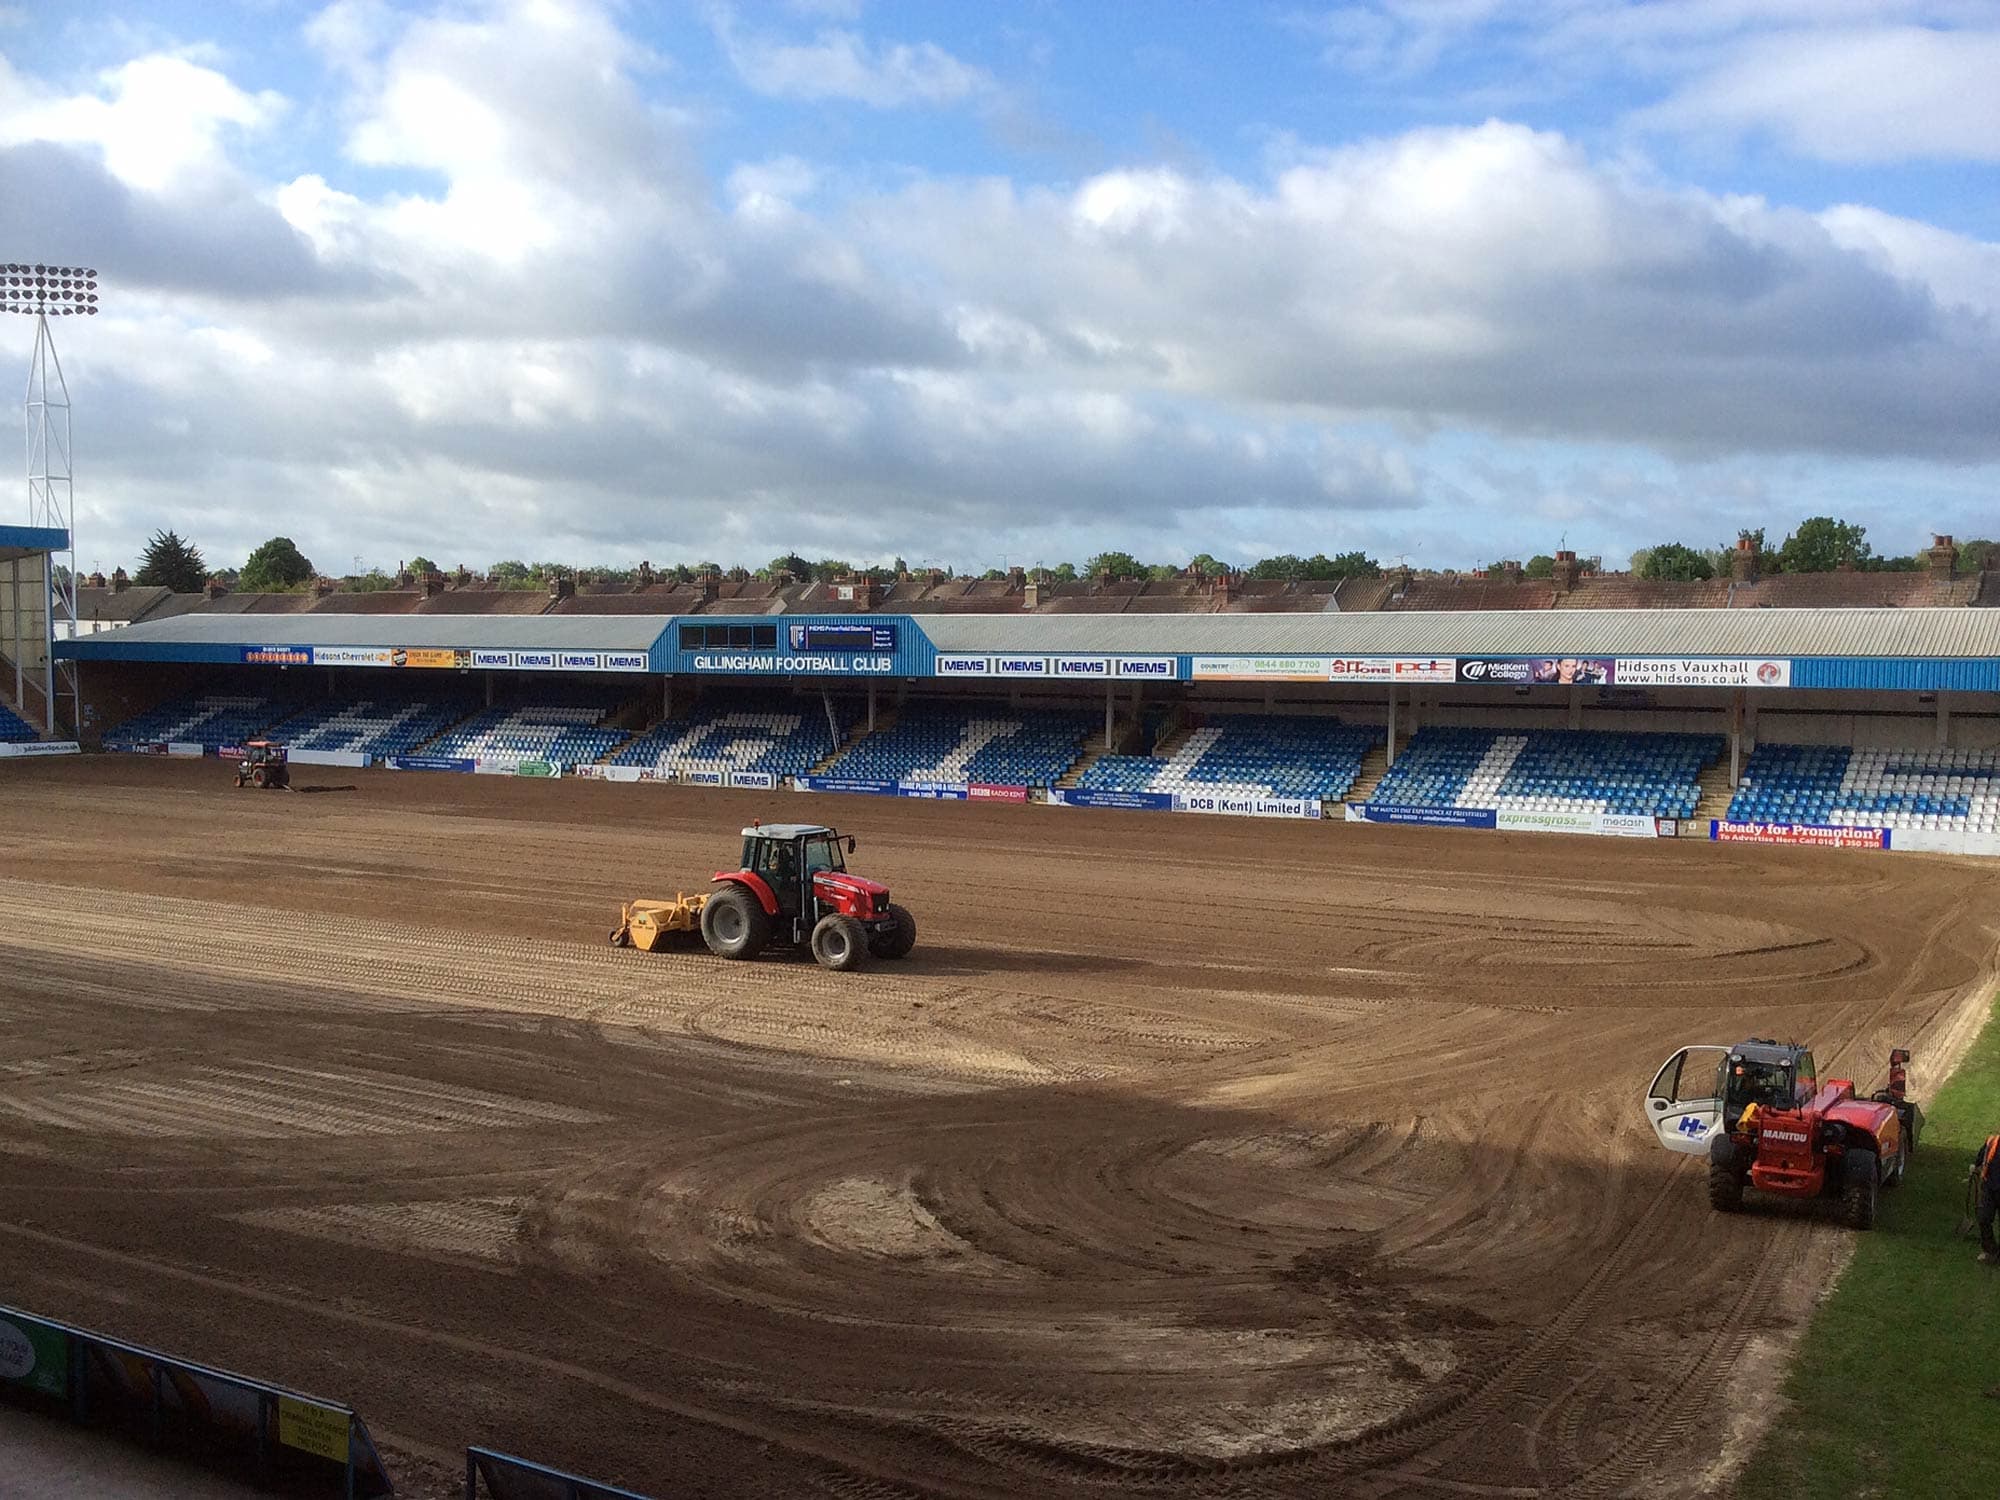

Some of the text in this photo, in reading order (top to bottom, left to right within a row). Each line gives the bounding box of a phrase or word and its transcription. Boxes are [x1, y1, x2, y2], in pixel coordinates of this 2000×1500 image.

[342, 652, 374, 662] Chevrolet
[478, 655, 508, 664] MEMS
[520, 656, 551, 666] MEMS
[564, 656, 596, 666] MEMS
[609, 657, 642, 667] MEMS
[694, 656, 892, 672] GILLINGHAM FOOTBALL CLUB
[944, 660, 984, 671] MEMS
[1001, 661, 1042, 672] MEMS
[1061, 662, 1104, 672] MEMS
[1122, 662, 1167, 673] MEMS
[1488, 663, 1529, 671] MidKent
[1617, 661, 1748, 673] Hidsons Vauxhall
[1490, 670, 1526, 680] College
[1617, 673, 1748, 685] www.hidsons.co.uk
[686, 774, 719, 784] MEMS
[734, 776, 769, 786] MEMS
[970, 788, 1026, 798] BBC RADIO KENT
[1190, 798, 1214, 810] DCB
[1218, 800, 1252, 814] (Kent)
[1256, 802, 1300, 814] Limited
[1380, 806, 1400, 814] MATCH
[1412, 808, 1445, 816] EXPERIENCE
[1718, 822, 1883, 840] Ready for Promotion?
[1732, 834, 1774, 842] Advertise
[1776, 836, 1796, 844] Here
[1762, 1130, 1808, 1142] MANITOU
